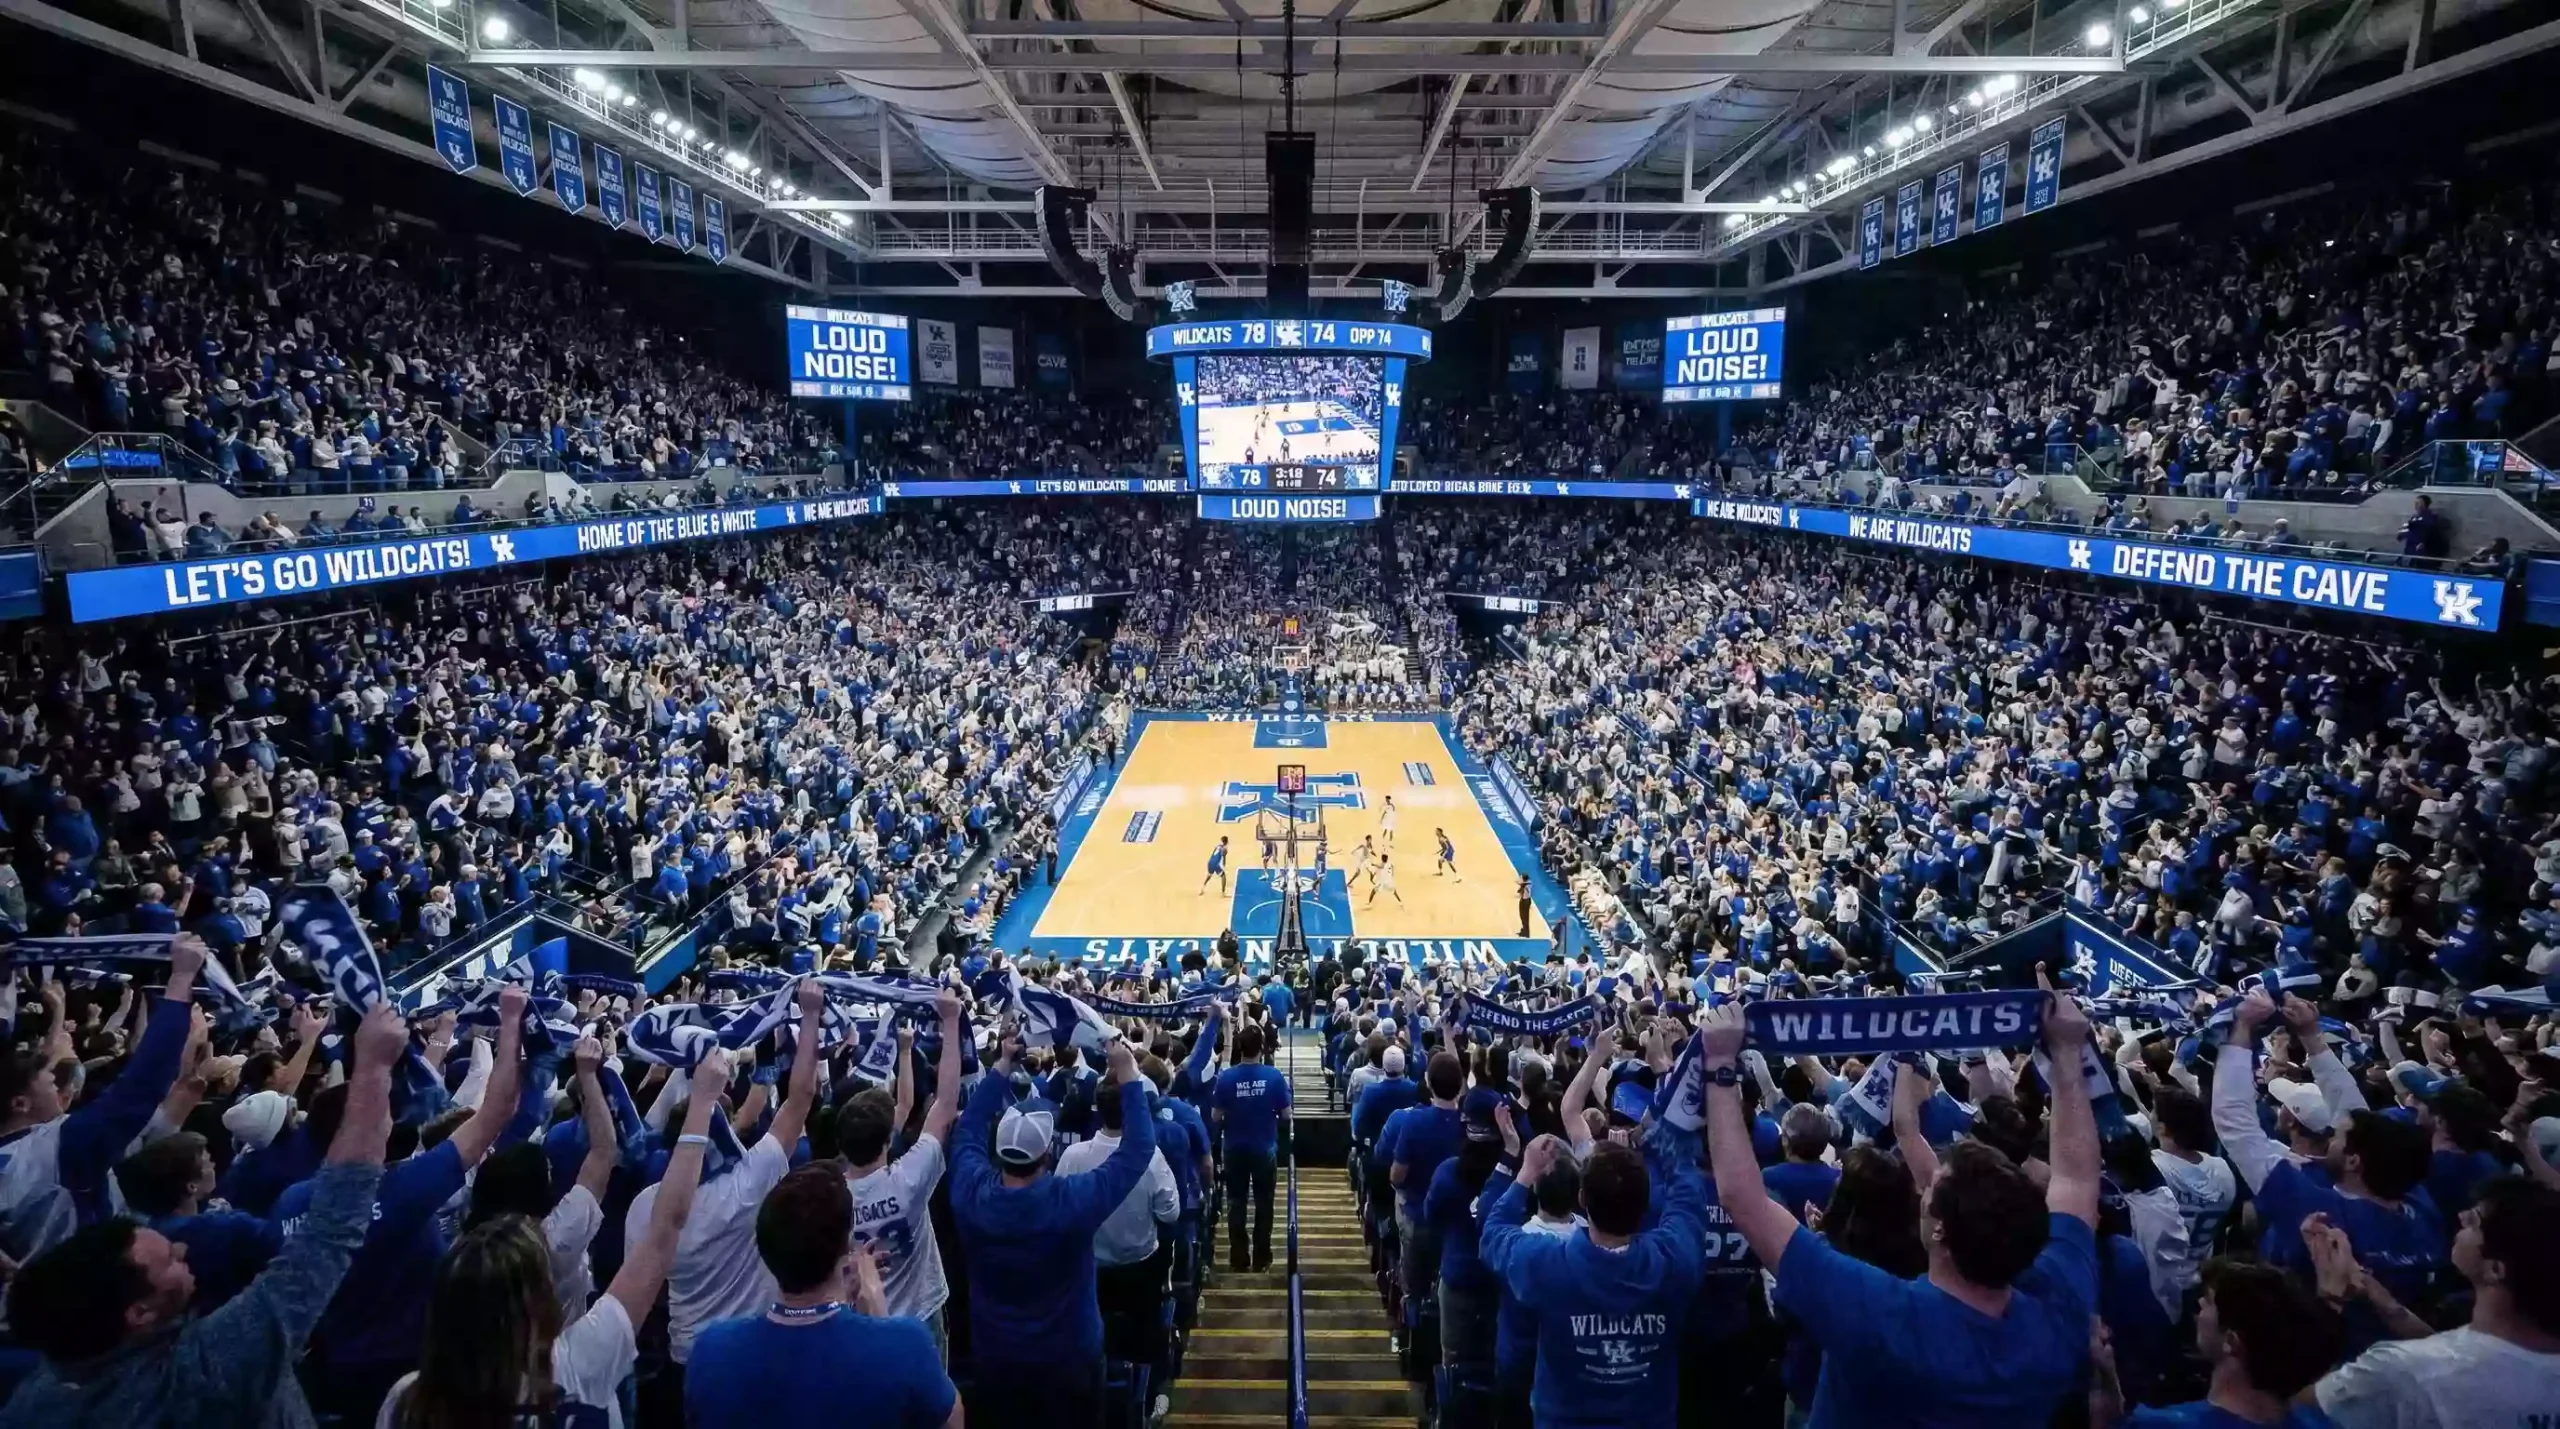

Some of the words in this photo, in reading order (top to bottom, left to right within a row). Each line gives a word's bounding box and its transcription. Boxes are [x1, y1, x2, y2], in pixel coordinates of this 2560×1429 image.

[812, 324, 886, 354] LOUD
[1173, 326, 1232, 345] WILDCATS
[1241, 323, 1266, 344] 78
[1312, 323, 1336, 344] 74
[1350, 328, 1376, 344] OPP
[1377, 329, 1392, 345] 74
[1687, 327, 1759, 356] LOUD
[804, 352, 896, 382] NOISE!
[1678, 354, 1767, 383] NOISE!
[1036, 480, 1061, 492] LET'S
[1240, 469, 1261, 486] 78
[1317, 469, 1337, 486] 74
[1231, 498, 1279, 519] LOUD
[1285, 498, 1347, 518] NOISE!
[1719, 500, 1735, 520] ARE
[1736, 503, 1783, 527] WILDCATS!
[577, 525, 624, 551] HOME
[627, 523, 646, 545] OF
[648, 519, 674, 542] THE
[677, 514, 709, 539] BLUE
[711, 512, 719, 534] &
[722, 509, 756, 532] WHITE
[1849, 514, 1867, 539] WE
[1869, 517, 1894, 542] ARE
[1896, 520, 1972, 552] WILDCATS
[165, 560, 264, 605] LET'S
[274, 554, 318, 589] GO
[326, 540, 471, 584] WILDCATS!
[2112, 544, 2215, 587] DEFEND
[2224, 556, 2287, 597] THE
[2292, 565, 2388, 611] CAVE
[1525, 1019, 1550, 1031] THE
[1570, 1313, 1667, 1337] WILDCATS
